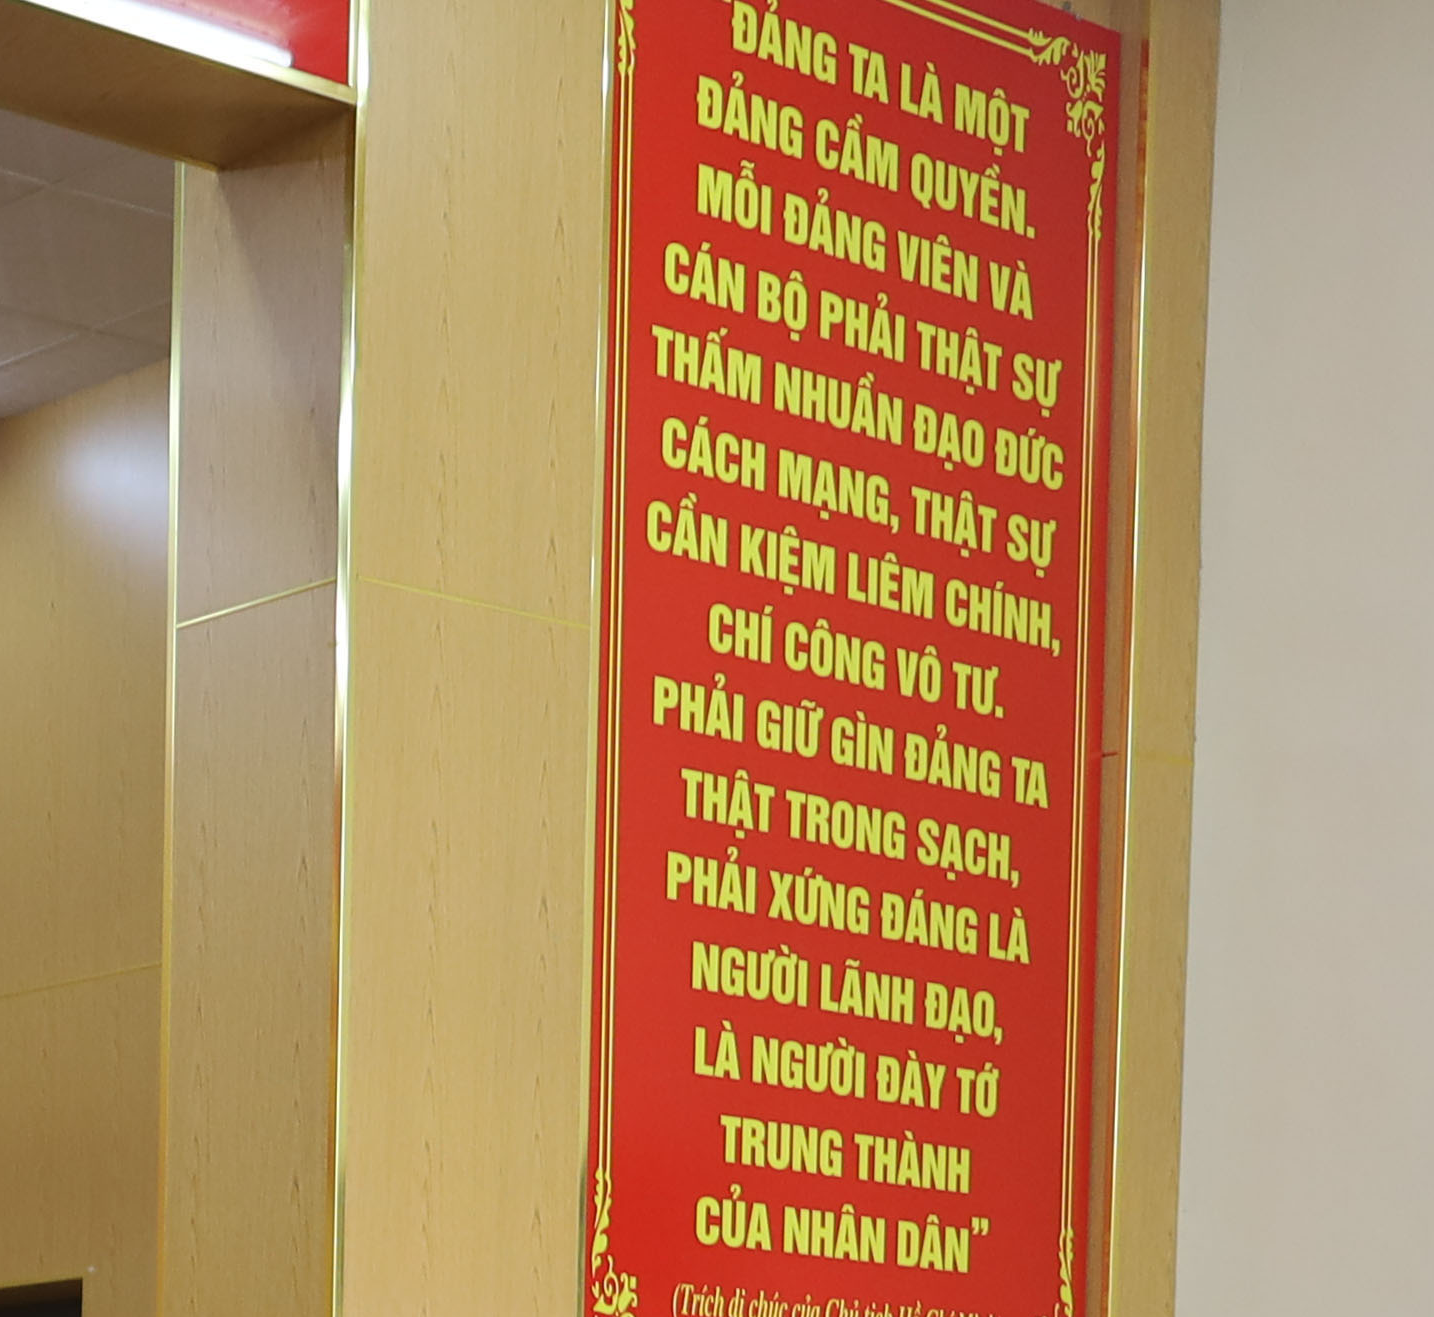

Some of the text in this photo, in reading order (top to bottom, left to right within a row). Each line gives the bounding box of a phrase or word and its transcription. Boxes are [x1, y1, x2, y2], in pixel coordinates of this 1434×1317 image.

[697, 71, 1036, 238] ĐẢNG CẦM QUYỀN.
[849, 44, 889, 103] TA
[901, 63, 943, 123] LÀ
[955, 84, 1030, 156] MỘT
[698, 160, 1033, 320] MỖI ĐẢNG VIÊN VÀ
[665, 242, 1063, 417] CÁN BỘ PHẢI THẬT SỰ
[652, 325, 1065, 491] THẤM NHUẦN ĐẠO ĐỨC
[662, 416, 1057, 577] CÁCH MẠNG, THẬT SỰ
[647, 493, 1060, 656] CẦN KIỆM LIÊM CHÍNH,
[709, 604, 1004, 718] CHÍ CÔNG VÔ TƯ.
[654, 673, 1049, 808] PHẢI GIỮ GÌN ĐẢNG TA
[681, 768, 1020, 887] THẬT TRONG SẠCH,
[667, 846, 1030, 964] PHẢI XỨNG ĐÁNG LÀ
[692, 942, 1003, 1044] NGƯỜI LÃNH ĐẠO,
[695, 1021, 1000, 1117] LÀ NGƯỜI ĐÀY TỚ
[721, 1115, 970, 1193] TRUNG THÀNH
[696, 1184, 772, 1250] CỦA
[784, 1204, 886, 1263] NHÂN
